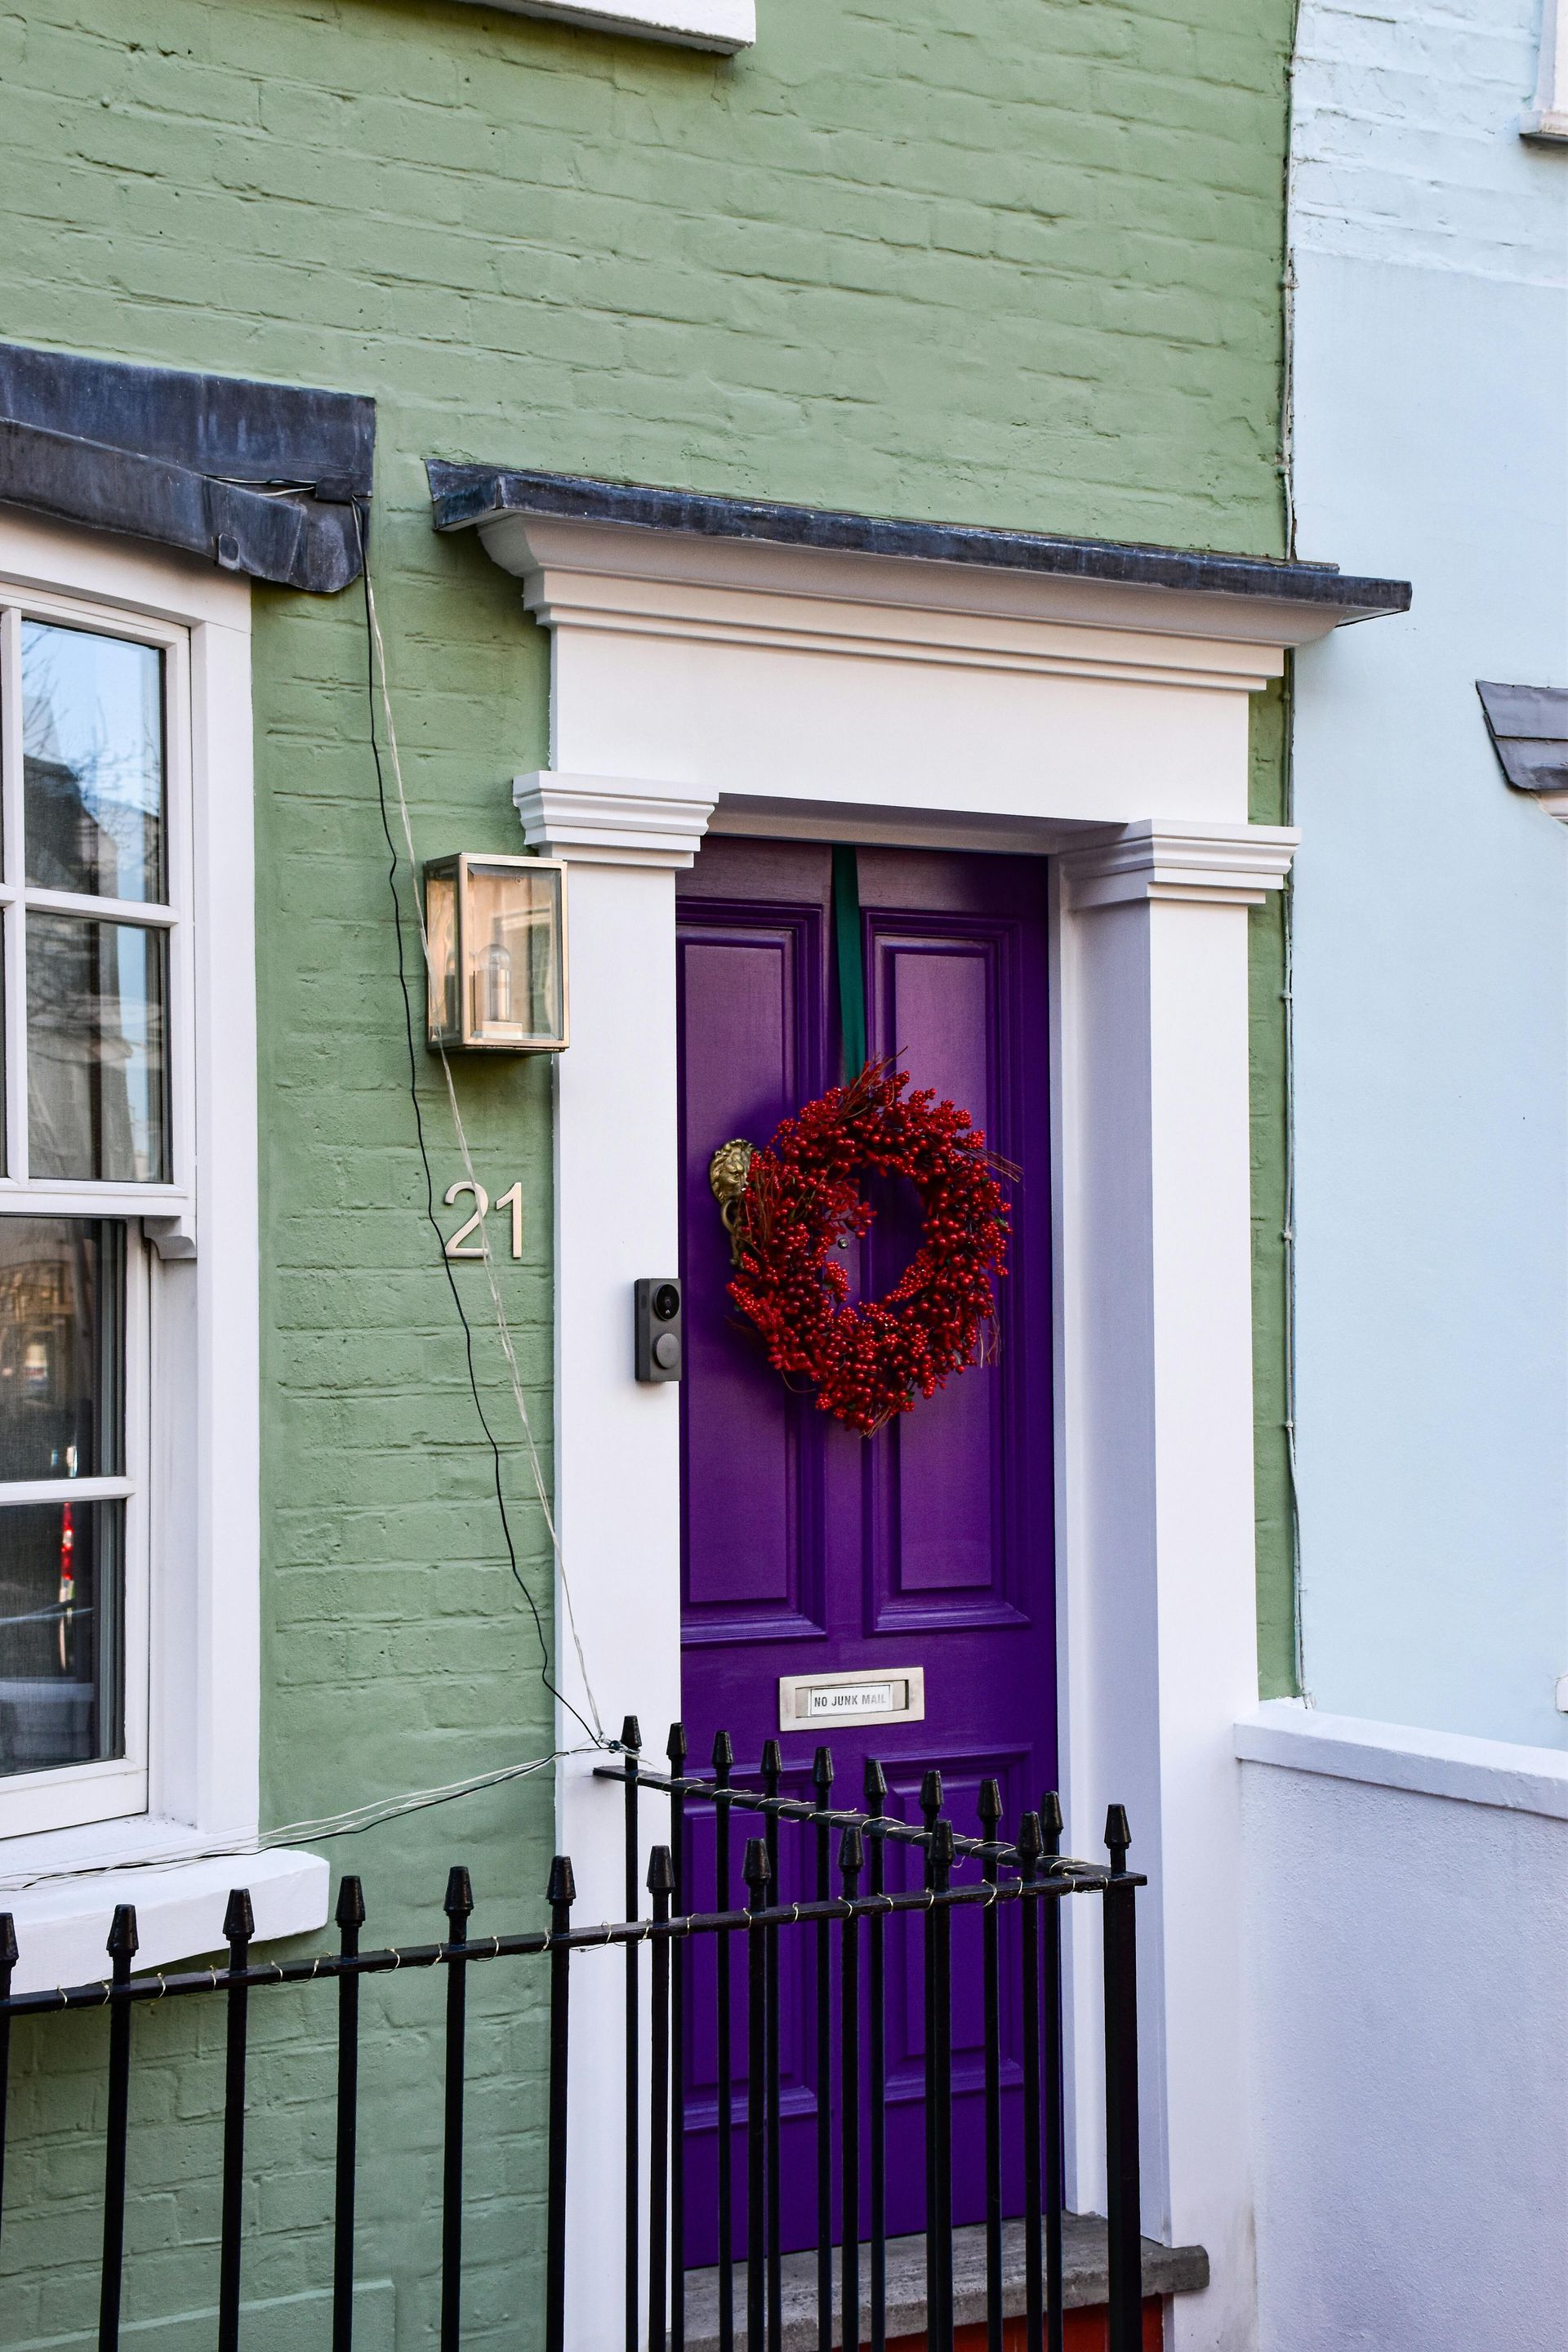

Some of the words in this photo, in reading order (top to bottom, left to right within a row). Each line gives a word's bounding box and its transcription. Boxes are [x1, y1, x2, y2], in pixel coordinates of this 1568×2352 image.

[444, 1181, 522, 1258] 21
[814, 1696, 828, 1708] NO
[831, 1695, 858, 1706] JUNK
[862, 1693, 887, 1705] MAIL
